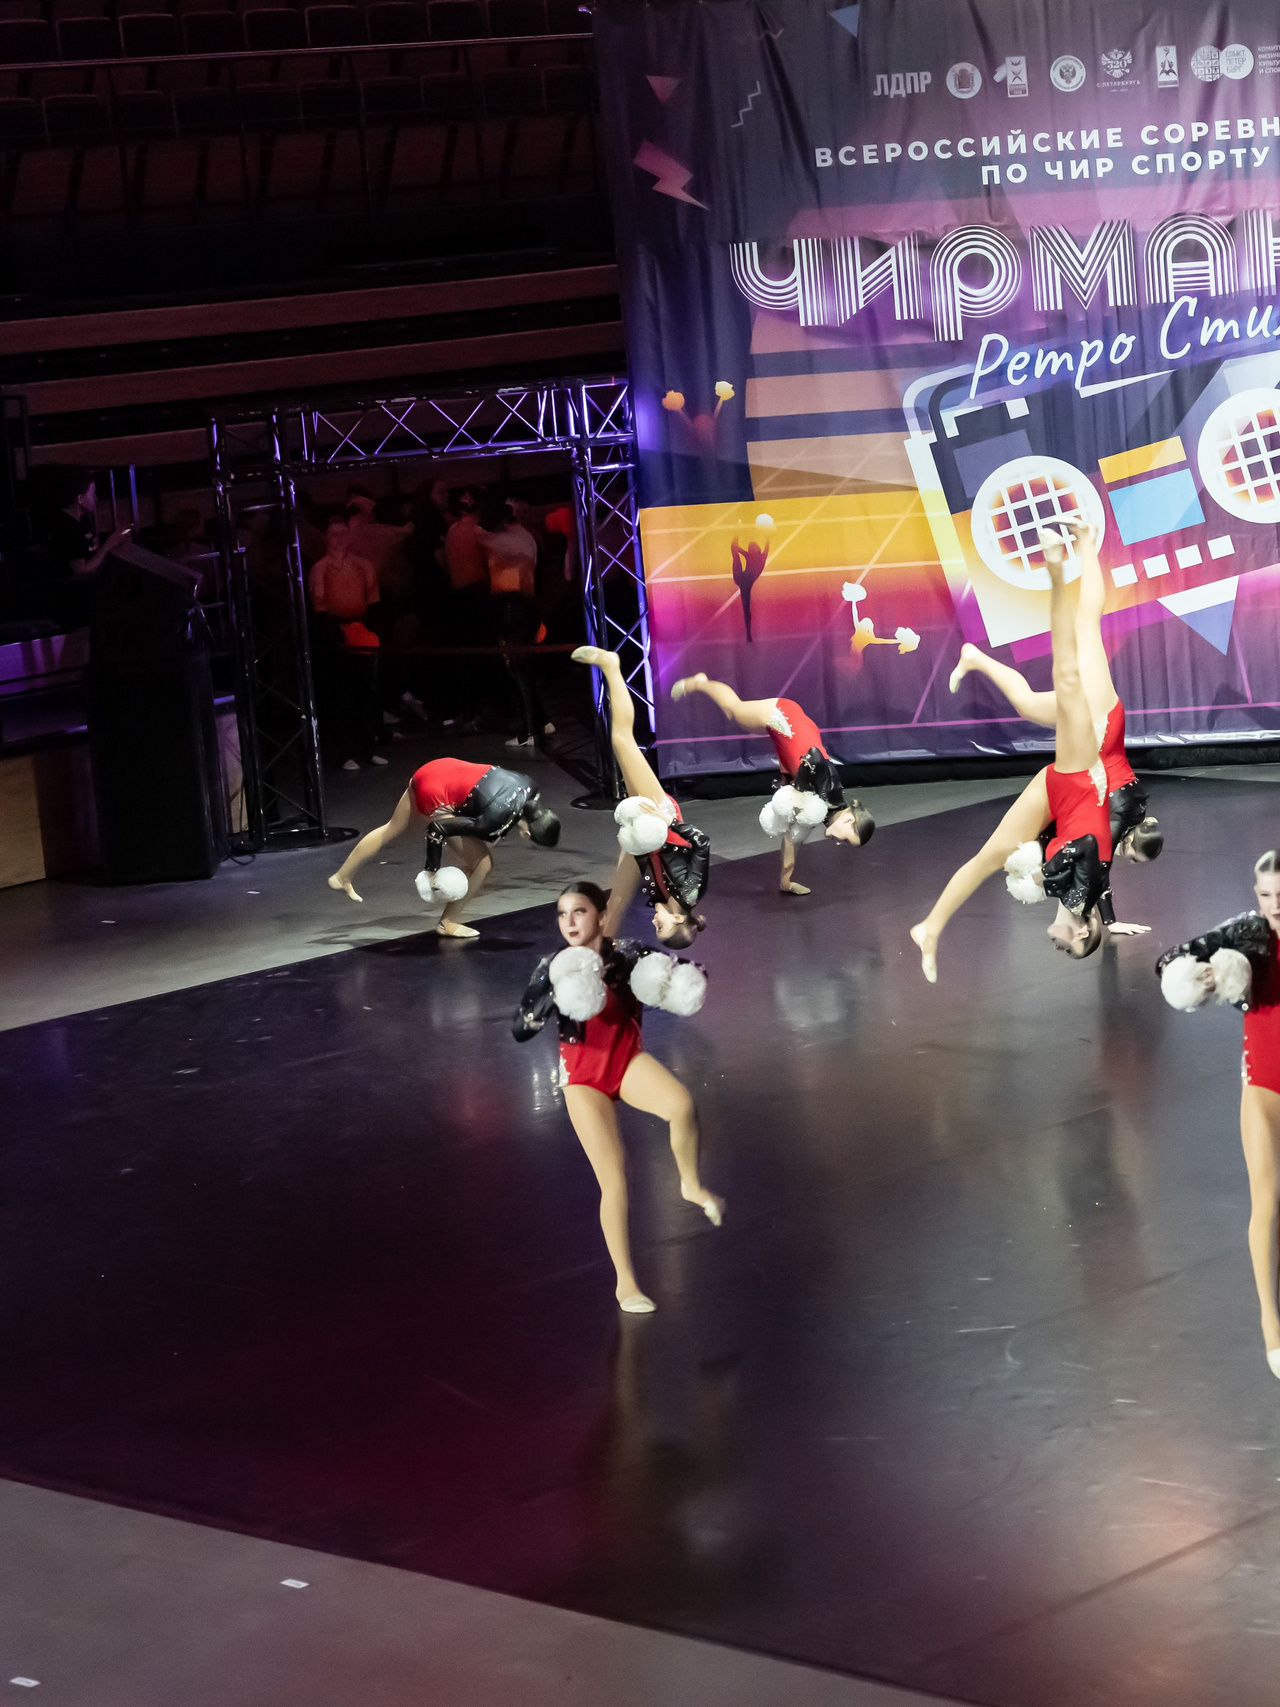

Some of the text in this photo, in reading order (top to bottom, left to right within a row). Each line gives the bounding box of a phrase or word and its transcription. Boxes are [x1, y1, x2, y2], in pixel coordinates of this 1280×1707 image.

[872, 71, 932, 99] ЛДПР
[814, 127, 1124, 168] ВСЕРОССИЙСКИЕ
[981, 146, 1270, 186] ПО ЧИР СПОРТУ
[968, 333, 1137, 400] Ретро
